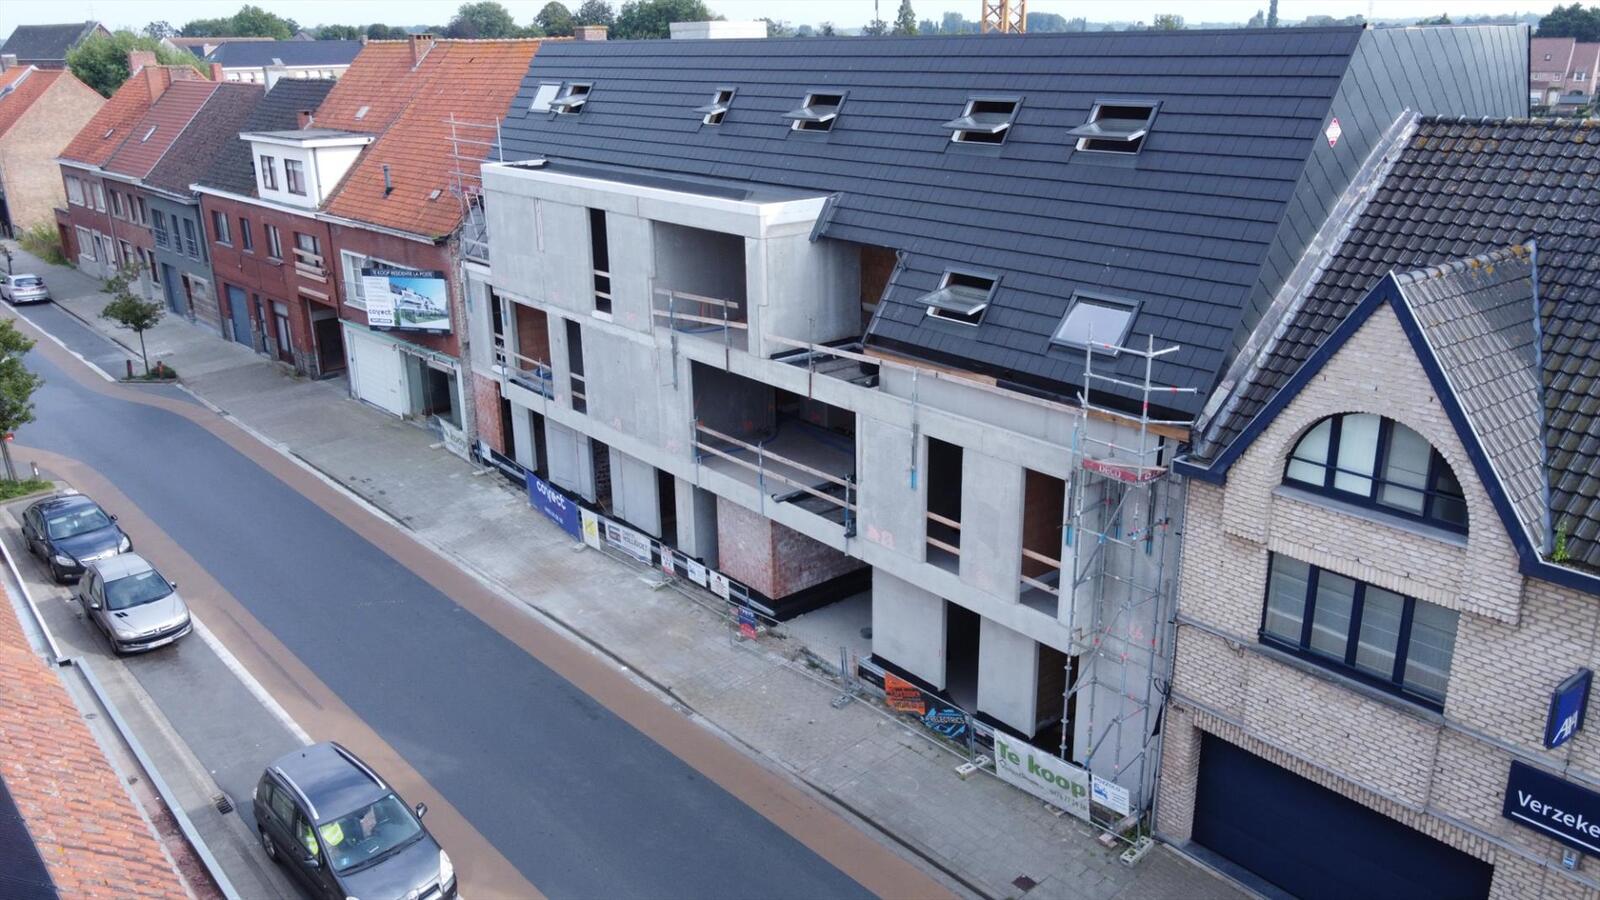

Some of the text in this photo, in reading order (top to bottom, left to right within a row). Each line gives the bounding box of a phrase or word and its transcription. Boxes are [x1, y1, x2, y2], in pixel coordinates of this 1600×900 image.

[1552, 710, 1579, 744] AXA
[996, 740, 1020, 766] Te
[1027, 754, 1086, 799] koop
[1518, 790, 1600, 839] Verzeke
